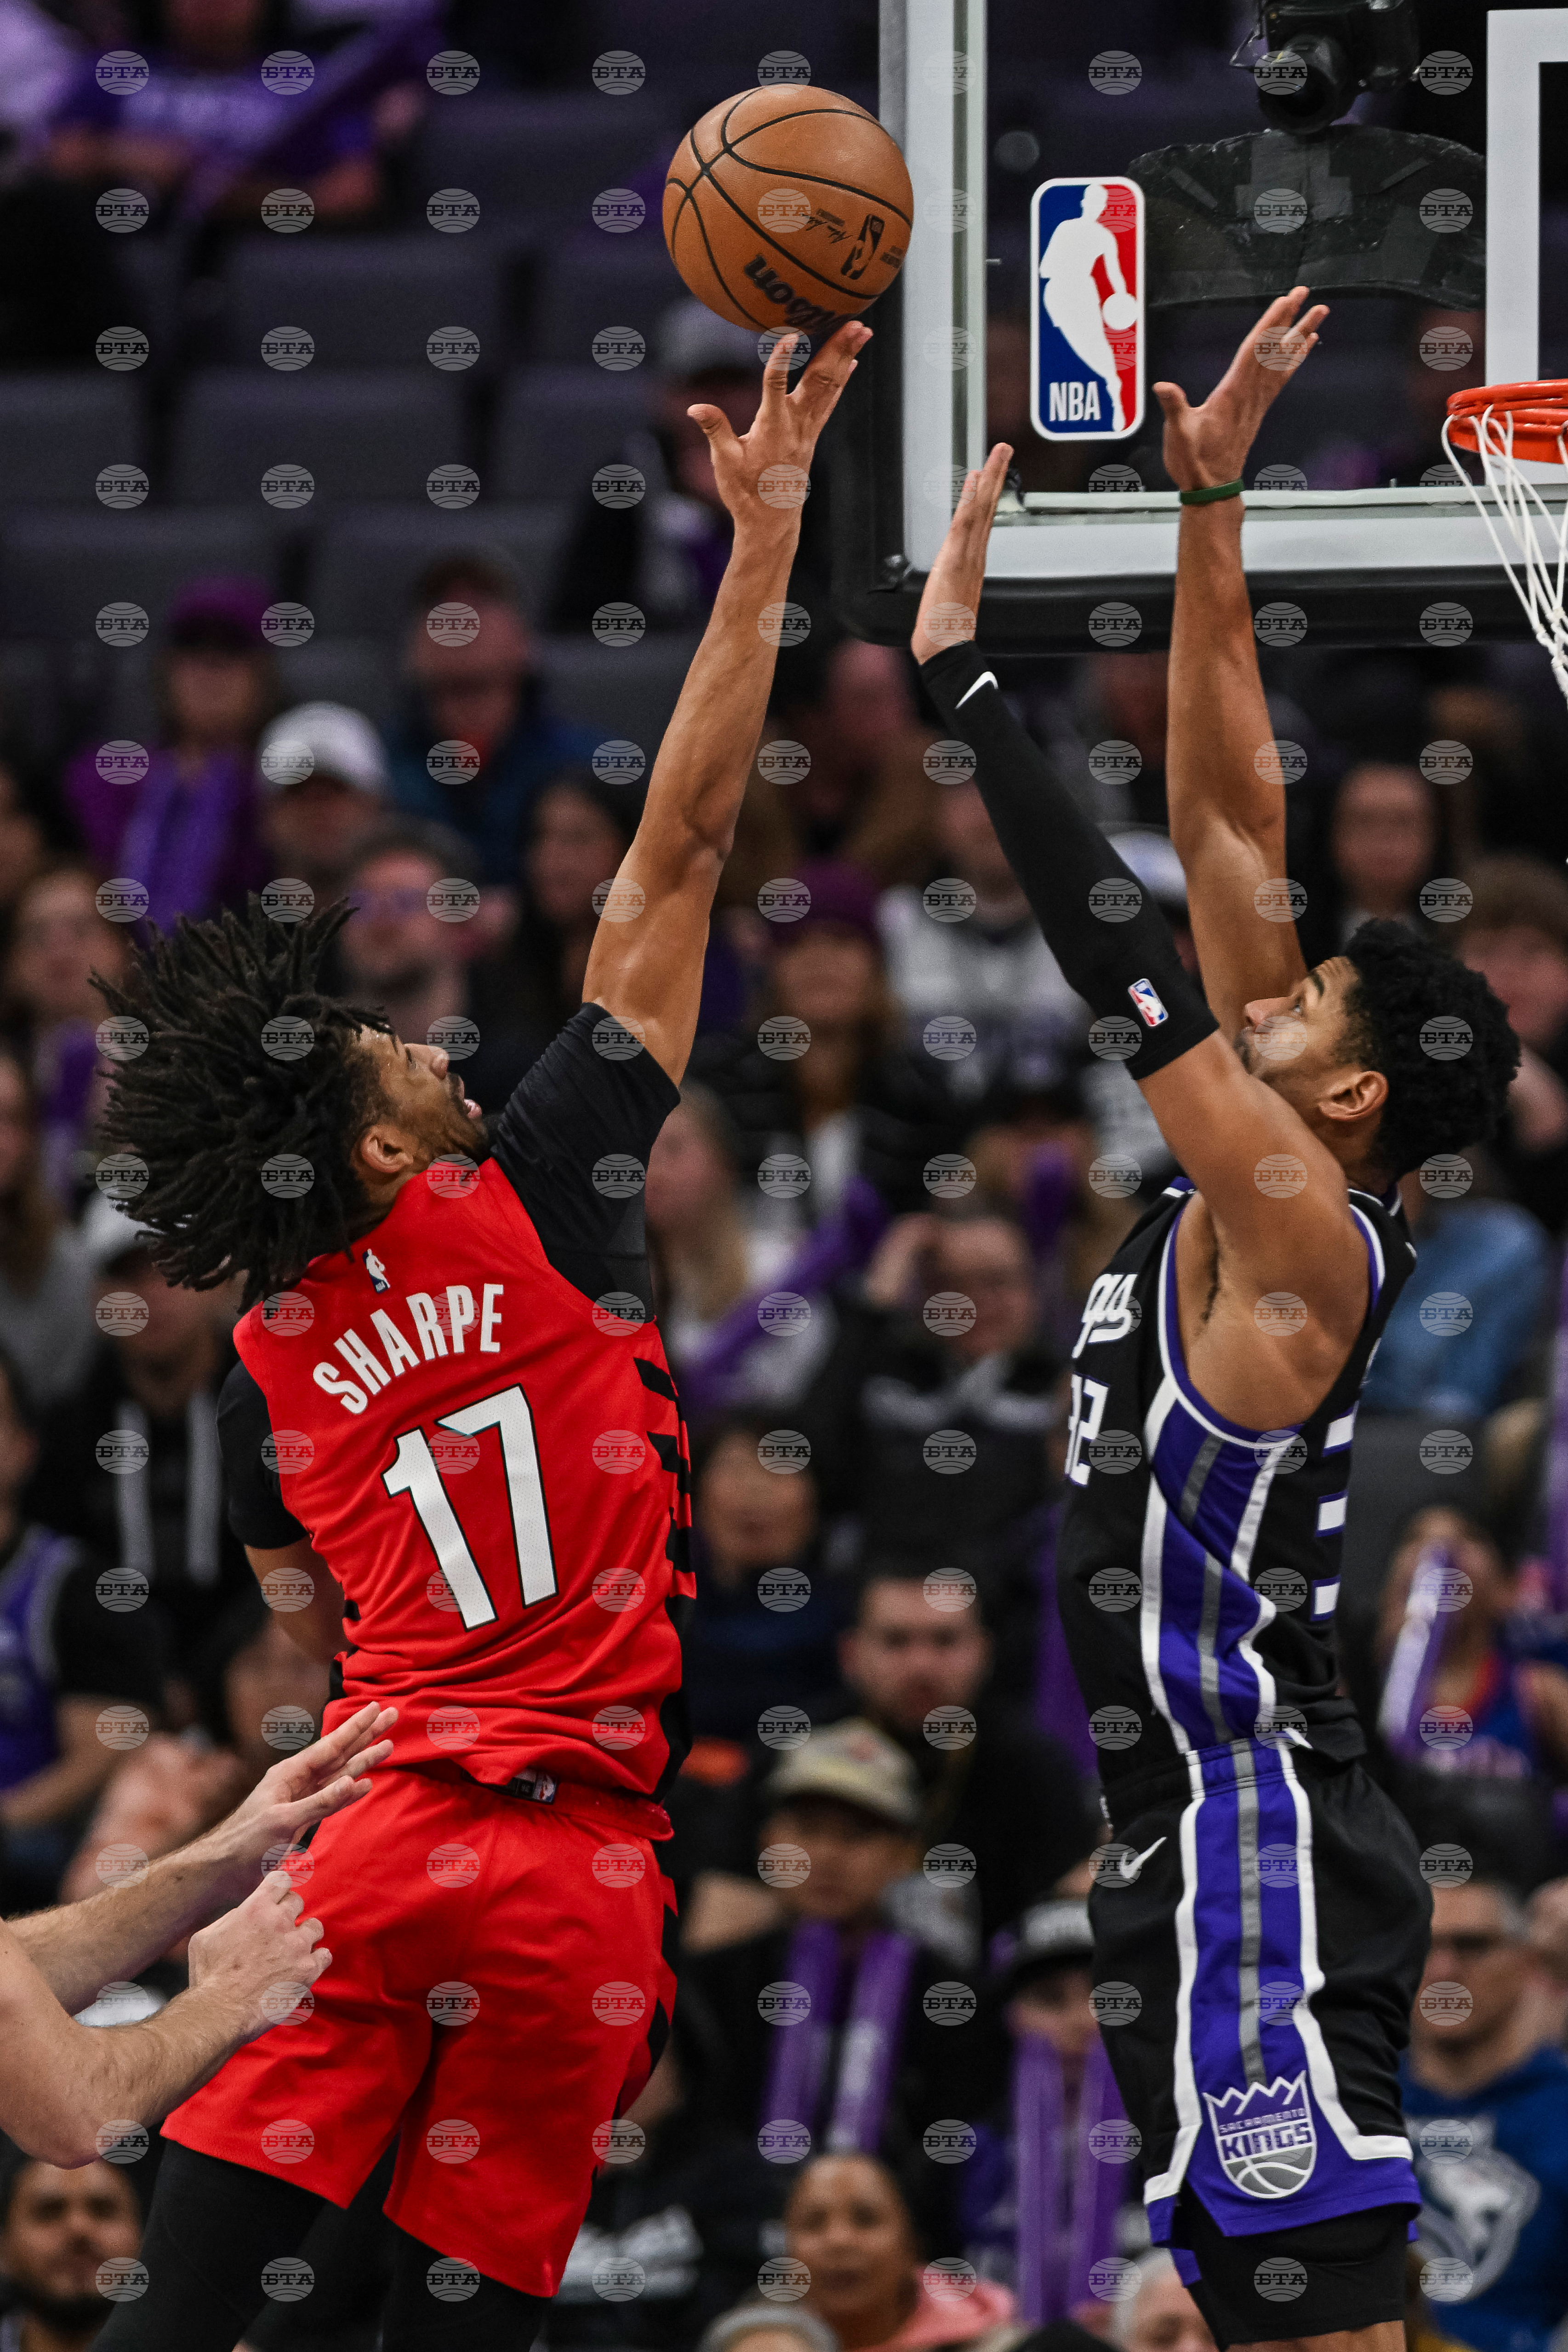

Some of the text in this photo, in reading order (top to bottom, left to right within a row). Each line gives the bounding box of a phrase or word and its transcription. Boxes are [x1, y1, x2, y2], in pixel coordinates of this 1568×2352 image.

[1049, 381, 1101, 422] NBA
[313, 1283, 504, 1415] SHARPE
[380, 1382, 559, 1632] 17
[1220, 2121, 1312, 2161] KINGS
